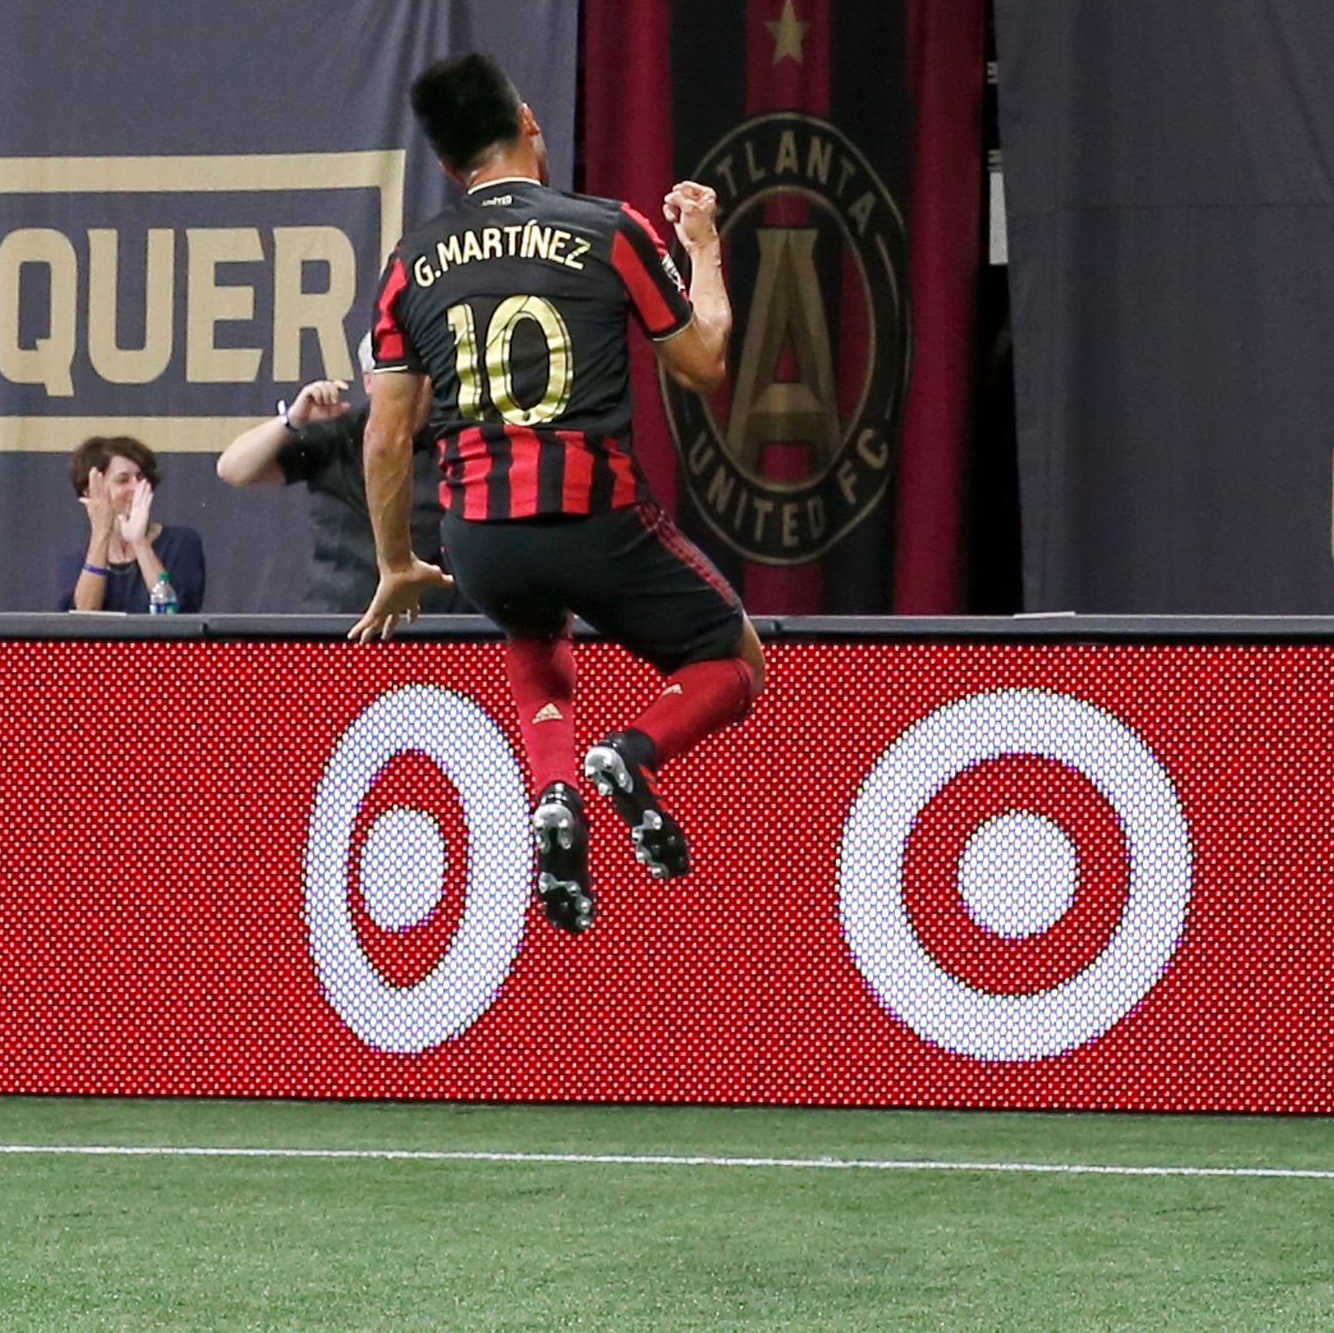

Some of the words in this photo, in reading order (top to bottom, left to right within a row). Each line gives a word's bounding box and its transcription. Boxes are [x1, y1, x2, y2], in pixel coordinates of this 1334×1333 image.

[714, 129, 879, 235] TLANTA
[413, 219, 592, 289] G.MARTÍNEZ
[447, 294, 573, 426] 10
[688, 427, 827, 549] UNITED
[837, 426, 889, 505] FC
